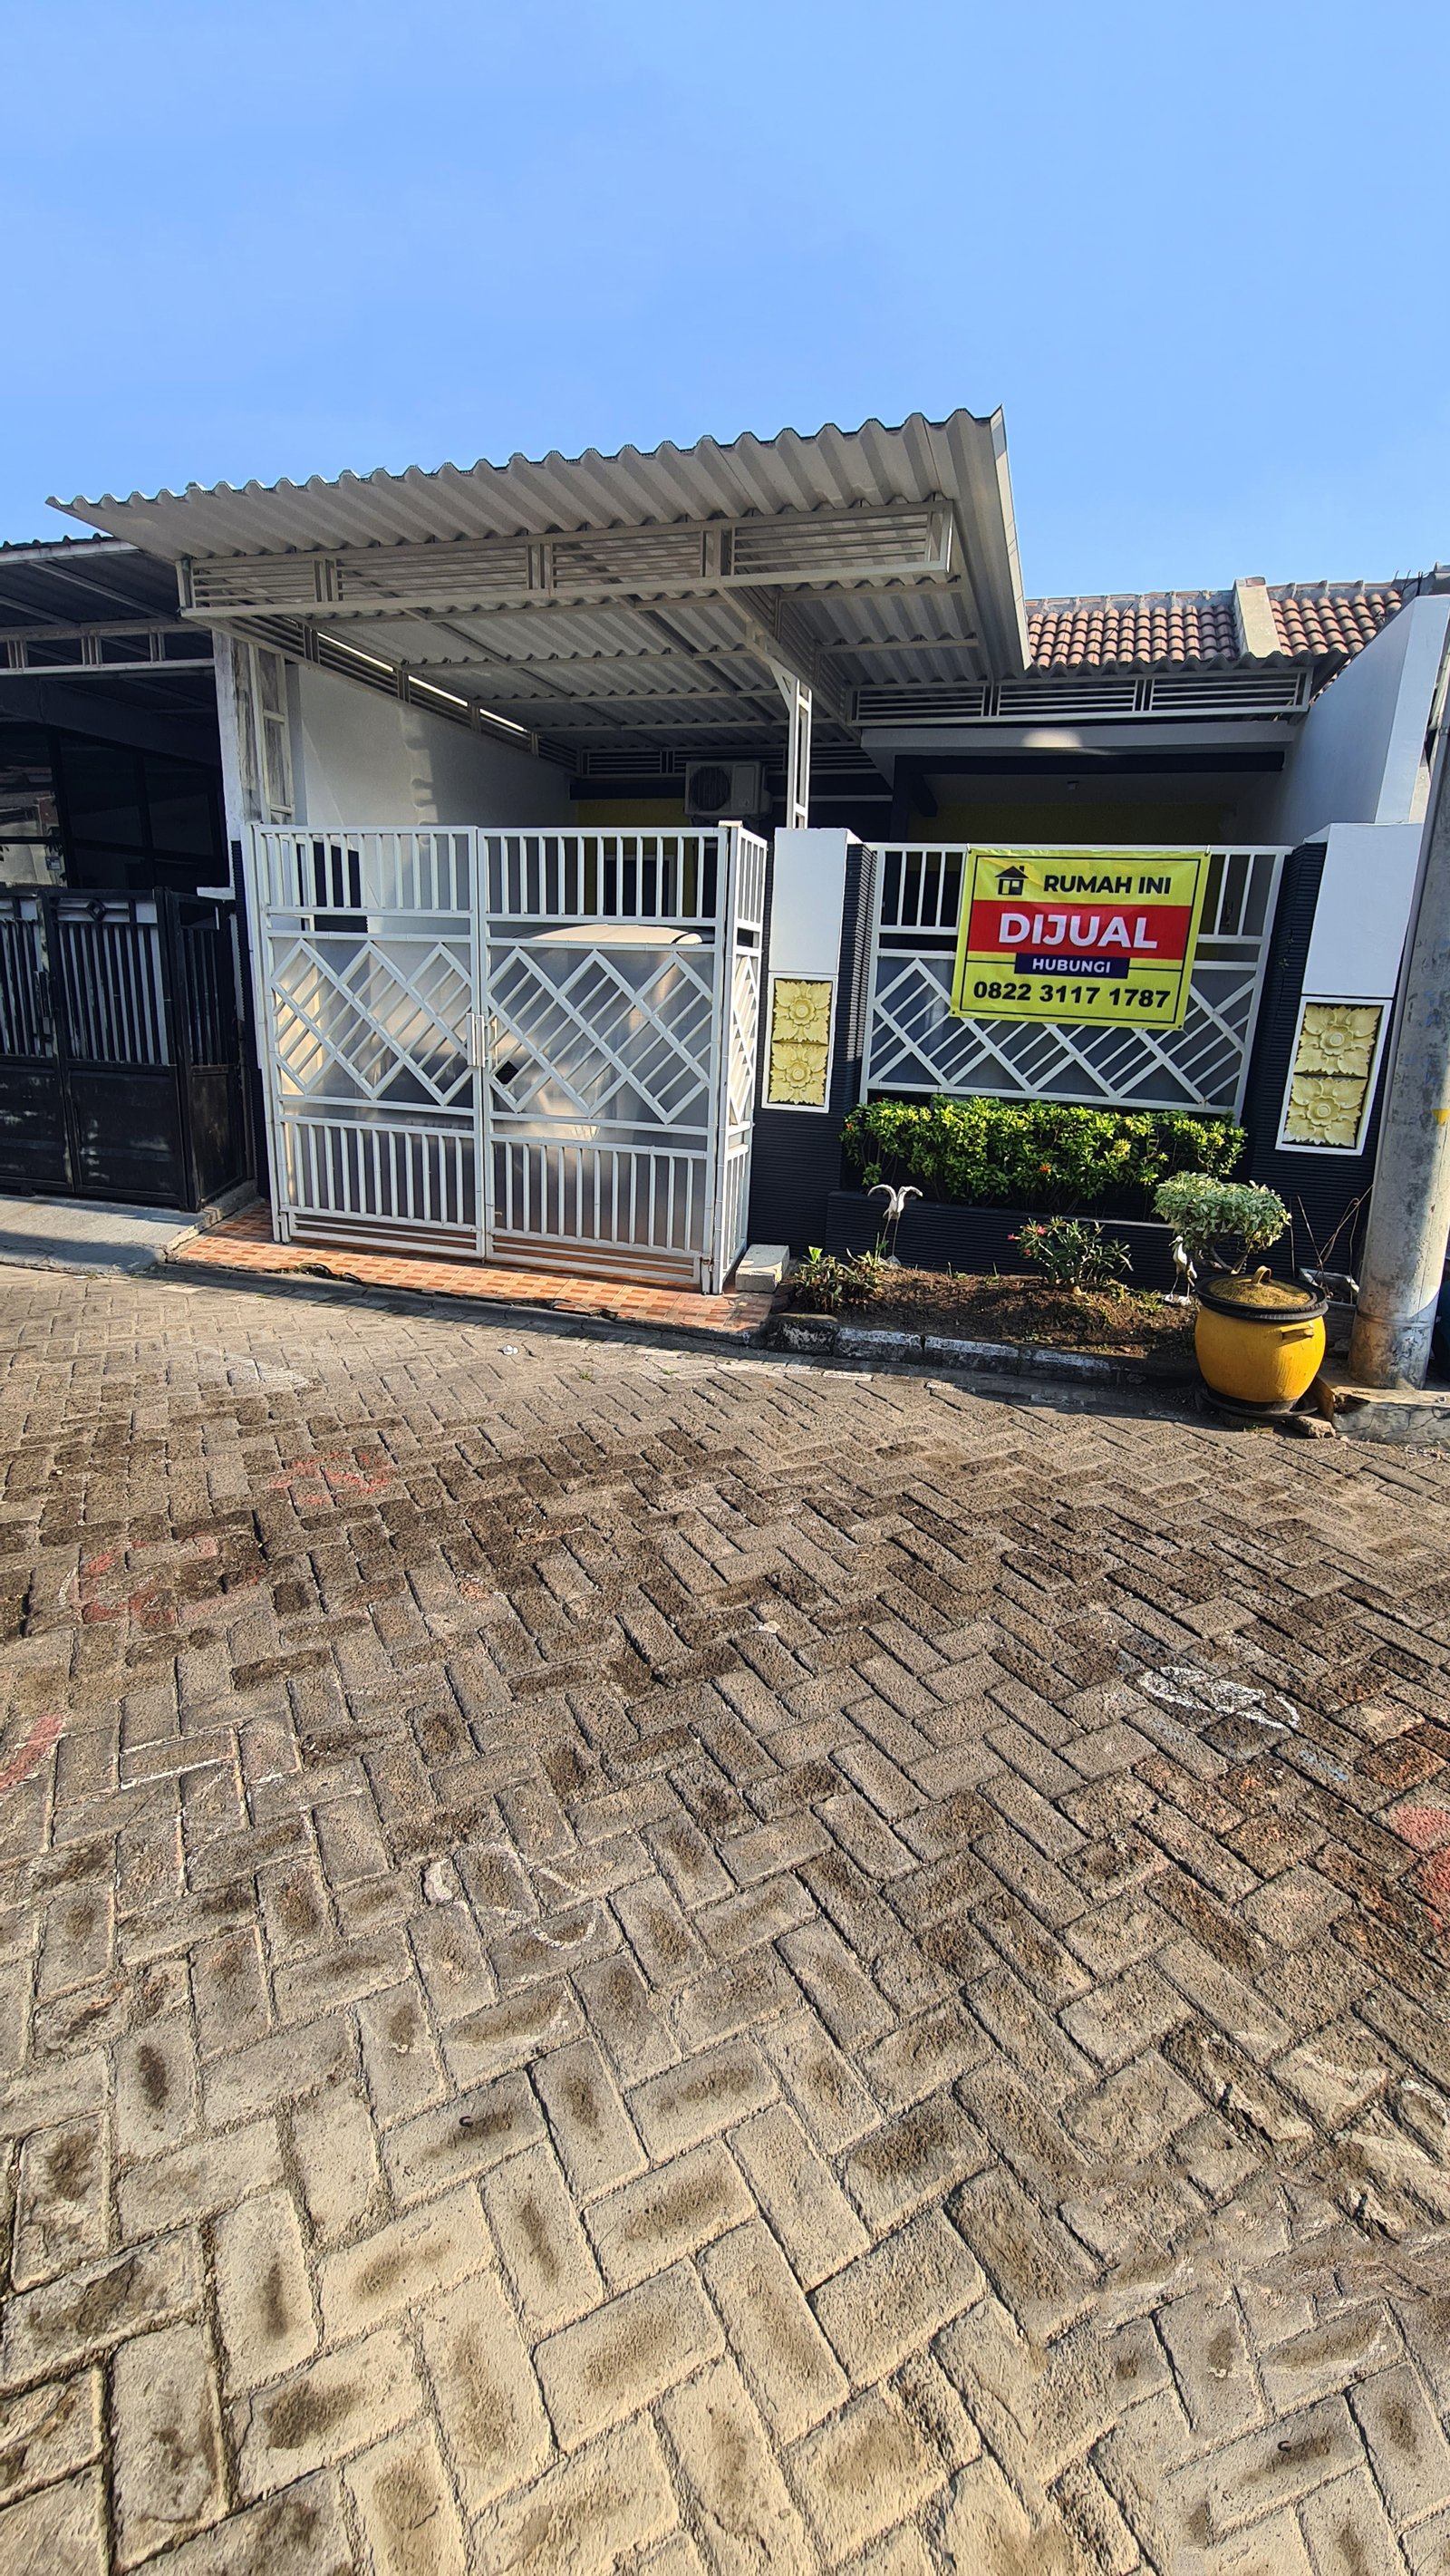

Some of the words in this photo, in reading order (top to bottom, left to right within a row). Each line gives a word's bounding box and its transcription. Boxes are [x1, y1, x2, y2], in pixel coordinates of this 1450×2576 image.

[1043, 875, 1132, 894] RUMAH
[1138, 876, 1171, 895] INI
[999, 913, 1157, 949] DIJUAL
[1032, 958, 1111, 973] HUBUNGI
[973, 982, 1031, 1001] 0822
[1039, 985, 1100, 1004] 3117
[1109, 988, 1171, 1008] 1787
